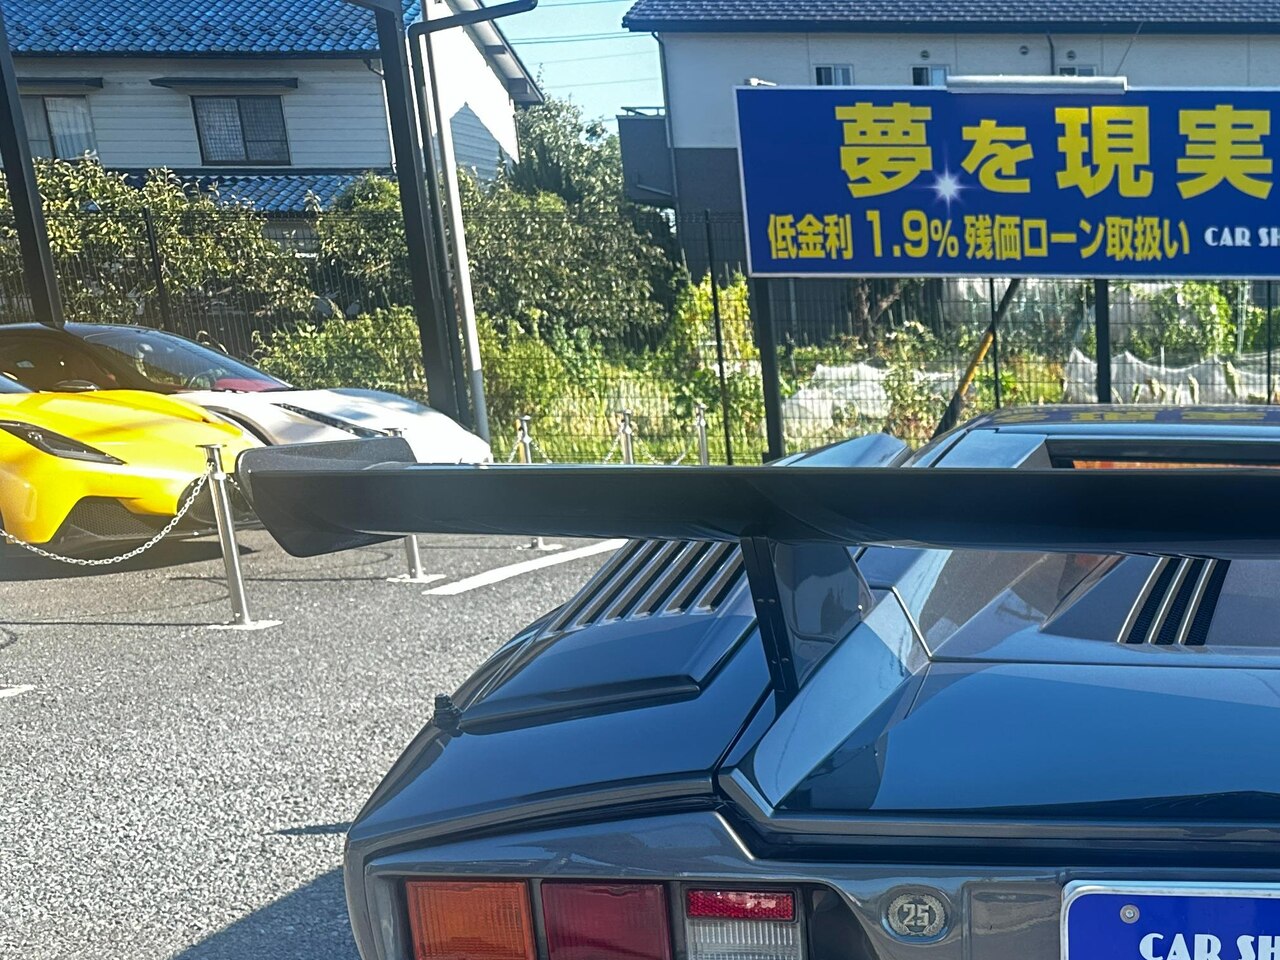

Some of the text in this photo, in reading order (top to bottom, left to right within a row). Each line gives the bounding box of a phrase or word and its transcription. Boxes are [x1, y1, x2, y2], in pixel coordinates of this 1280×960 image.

[768, 210, 1191, 261] 低金利 1.9% 残価ローン取扱い
[1204, 227, 1252, 247] CAR
[903, 903, 929, 926] 25
